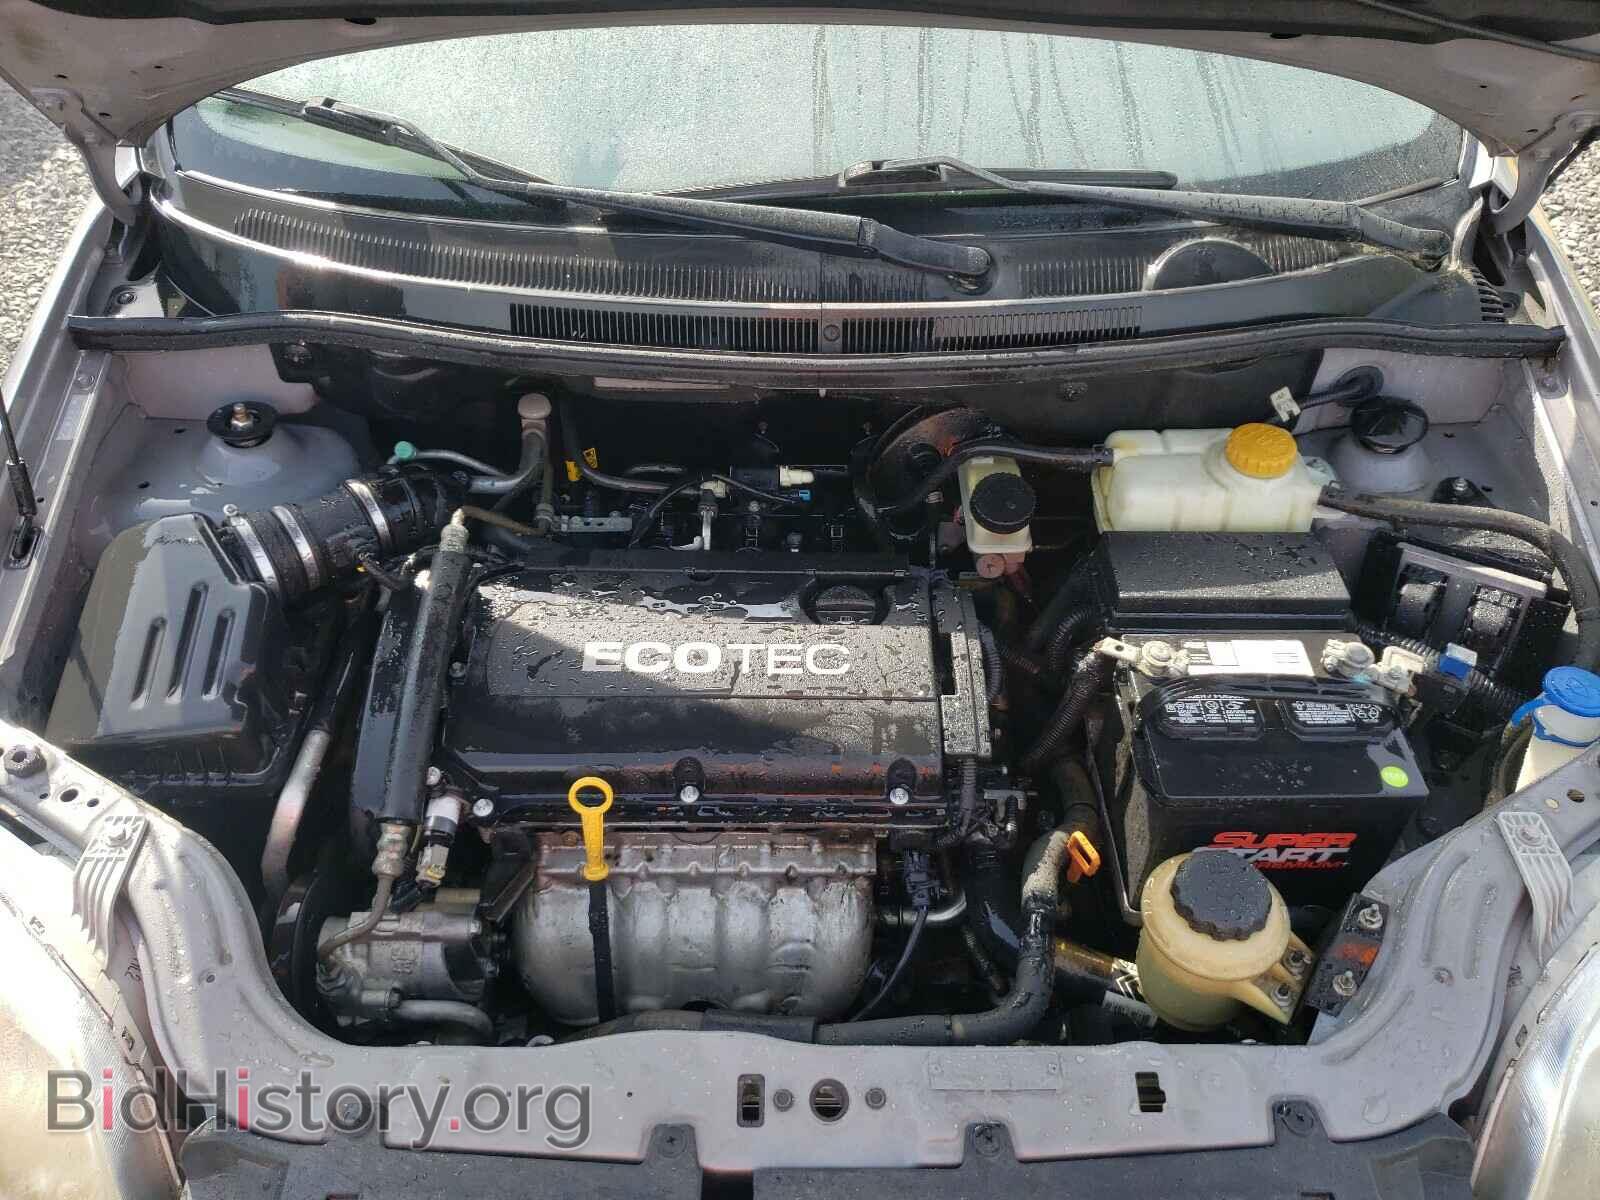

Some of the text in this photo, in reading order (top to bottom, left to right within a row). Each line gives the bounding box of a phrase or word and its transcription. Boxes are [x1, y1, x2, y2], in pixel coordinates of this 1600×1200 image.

[582, 640, 851, 675] ECOTEC
[1207, 831, 1358, 849] SUPER
[1193, 846, 1351, 864] TART
